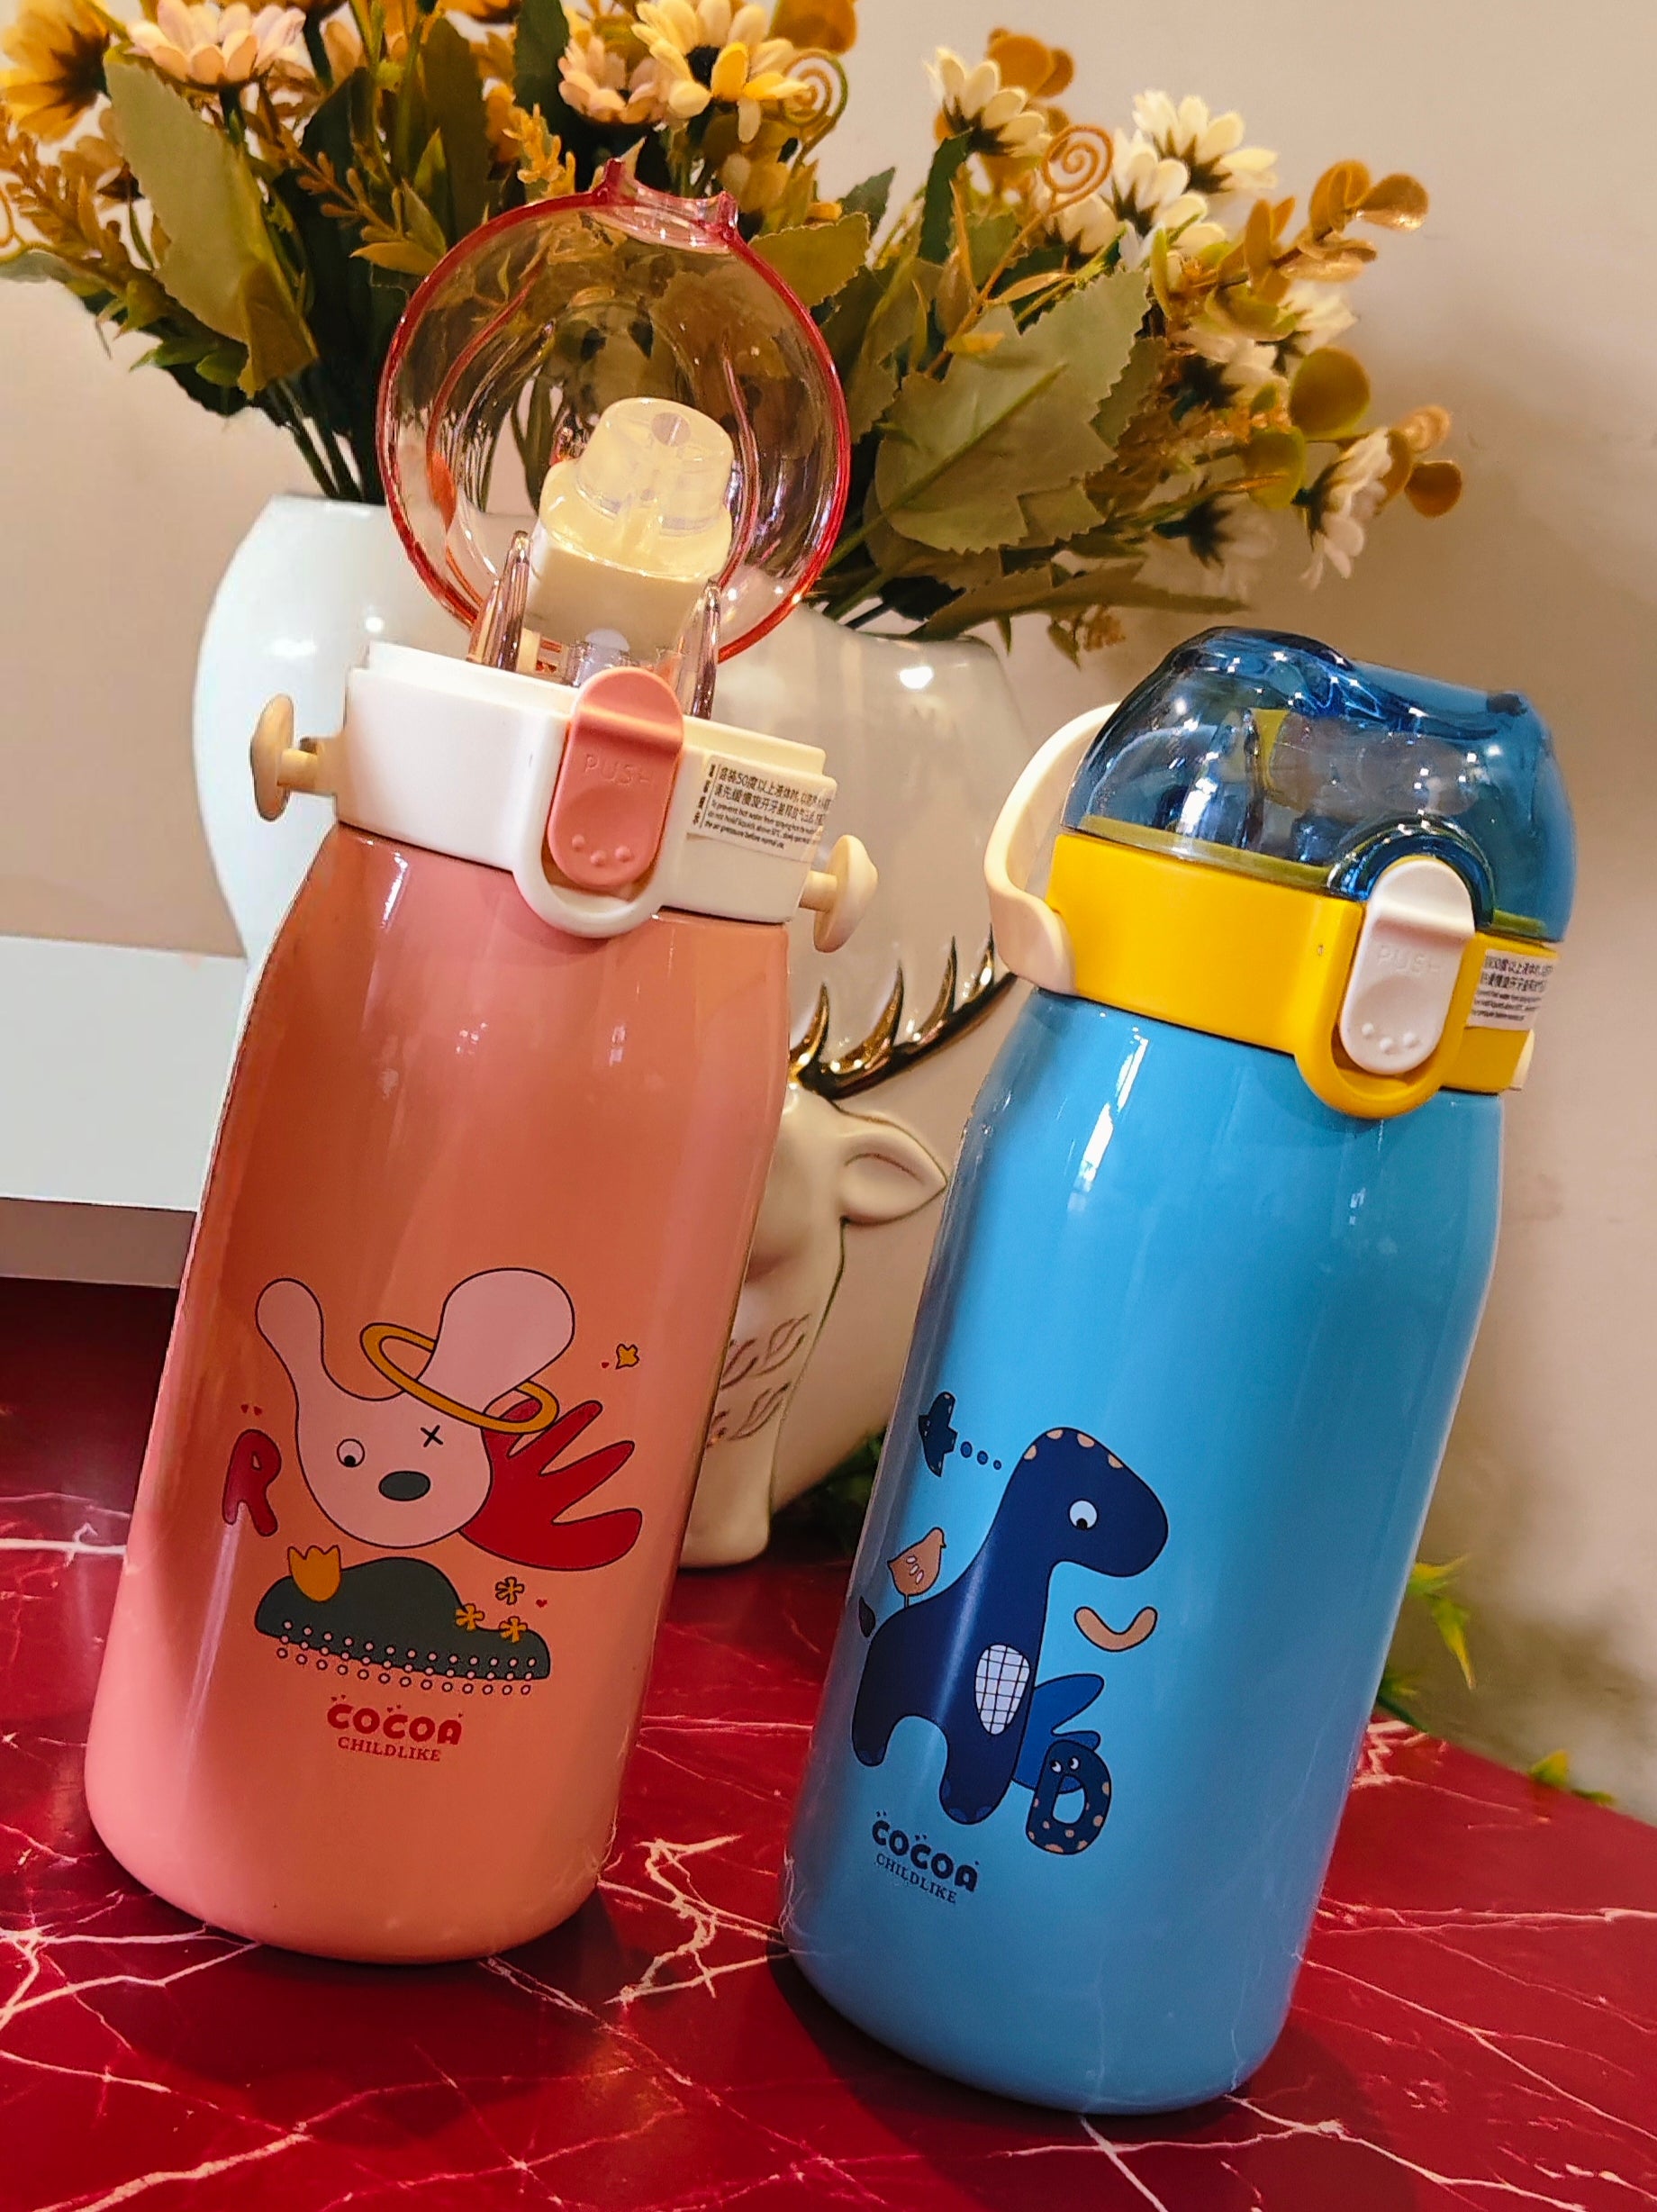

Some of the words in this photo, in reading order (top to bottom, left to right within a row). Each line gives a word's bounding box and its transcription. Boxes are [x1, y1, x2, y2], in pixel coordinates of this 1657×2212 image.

[327, 1698, 462, 1745] COCOA
[338, 1736, 441, 1762] CHILDLIKE
[872, 1818, 978, 1892] COCOA
[875, 1853, 957, 1904] CHILDLIKE
